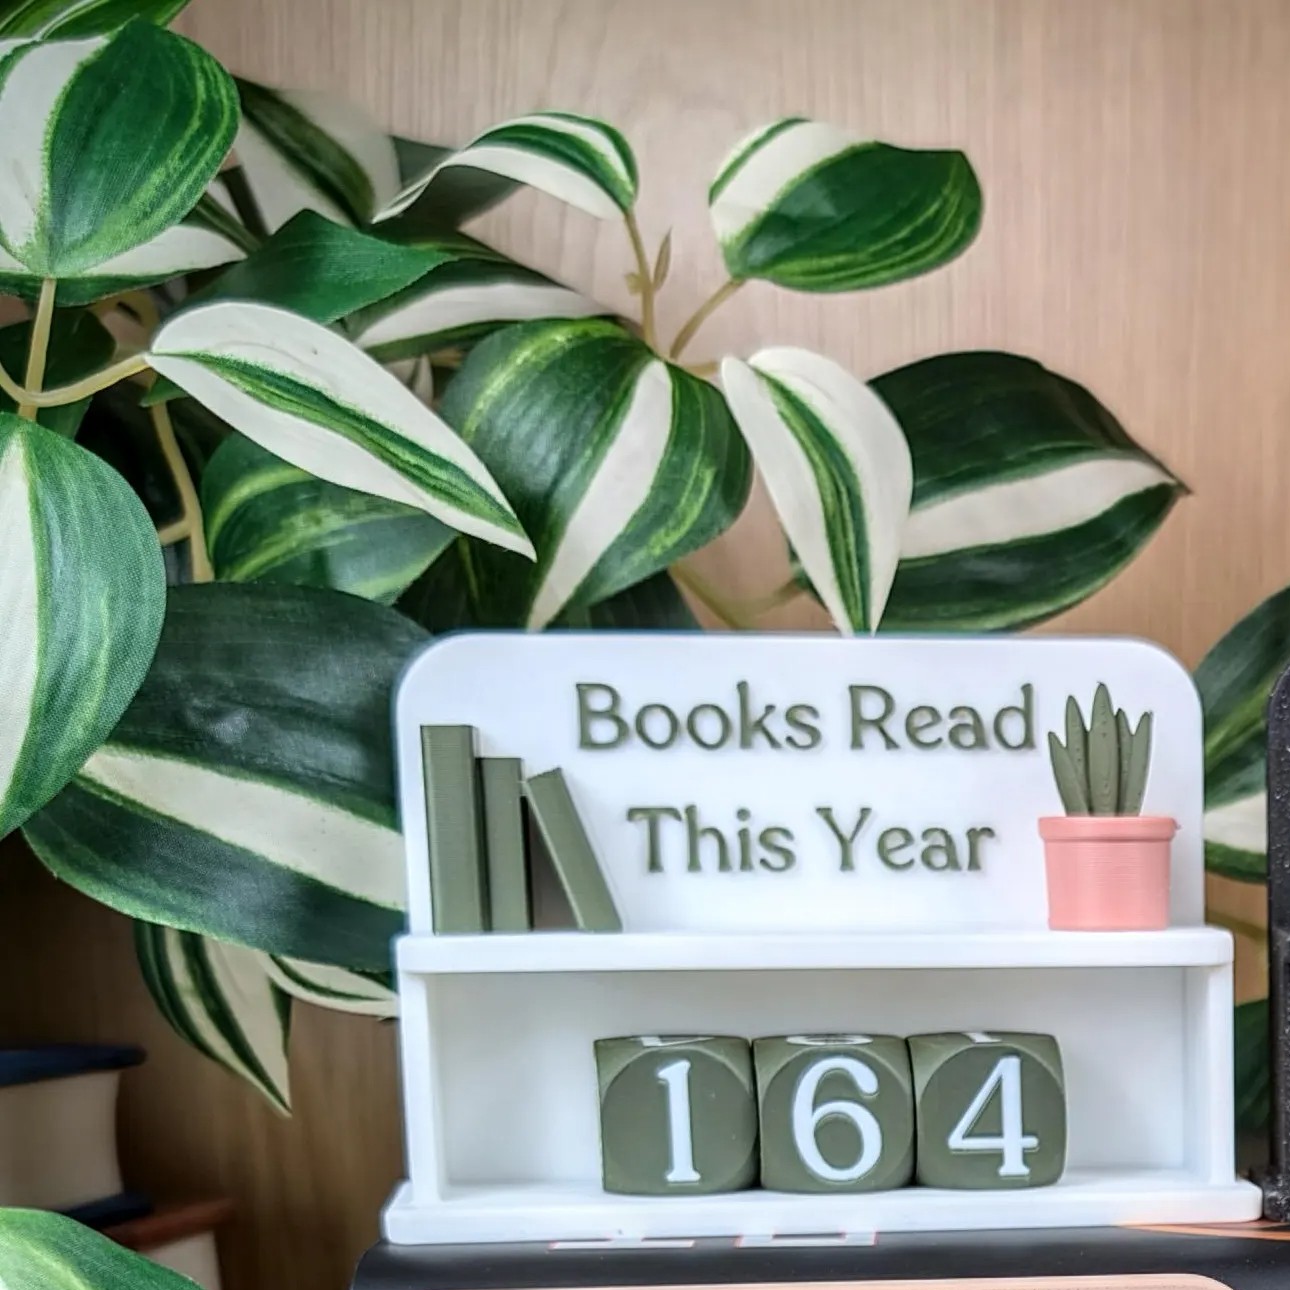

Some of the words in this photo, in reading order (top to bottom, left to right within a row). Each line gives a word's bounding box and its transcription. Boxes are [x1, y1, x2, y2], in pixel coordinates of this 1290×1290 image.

[575, 680, 822, 752] Books
[847, 682, 1037, 752] Read
[626, 804, 796, 875] This
[815, 805, 997, 872] Year
